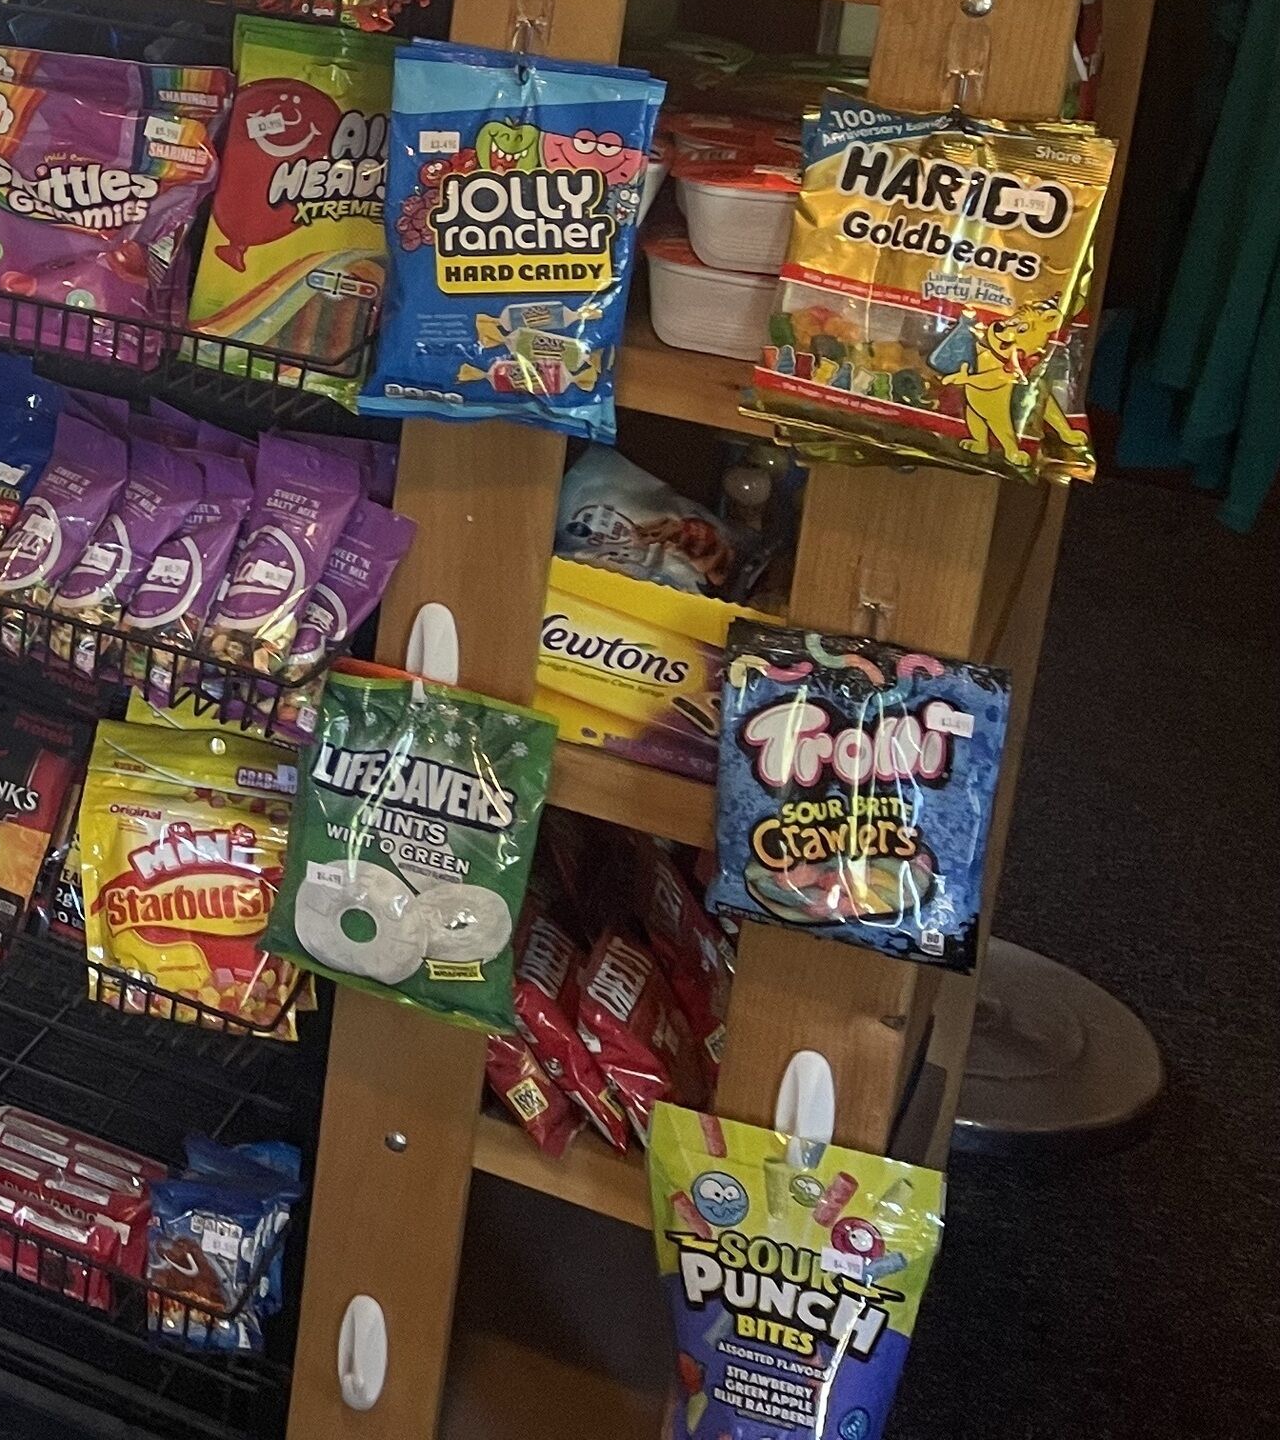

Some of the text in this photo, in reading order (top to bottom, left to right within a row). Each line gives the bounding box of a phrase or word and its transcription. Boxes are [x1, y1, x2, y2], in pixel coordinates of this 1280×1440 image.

[822, 123, 904, 147] Anniversary
[1035, 145, 1083, 164] Share
[435, 174, 595, 223] JOLLY
[444, 218, 607, 252] rancher
[842, 209, 1039, 279] Goldbears
[445, 262, 605, 283] HARD CANDY
[923, 281, 1014, 306] Party Hats
[265, 497, 319, 520] SALTY MIX
[273, 488, 308, 506] SWEET
[348, 565, 370, 581] MIX
[744, 701, 950, 789] Trolli
[109, 803, 162, 821] Original
[360, 804, 447, 846] MINTS
[781, 797, 846, 823] SOUR
[379, 838, 396, 855] O
[399, 842, 471, 876] GREEN
[752, 816, 919, 870] Crawlers
[680, 1251, 887, 1356] PUNCH
[736, 1313, 814, 1356] BITES
[717, 1340, 775, 1367] ASSORTED
[713, 1386, 743, 1409] BLUE
[724, 1378, 813, 1414] GREEN APPLE
[726, 1365, 814, 1400] STRAWBERRY
